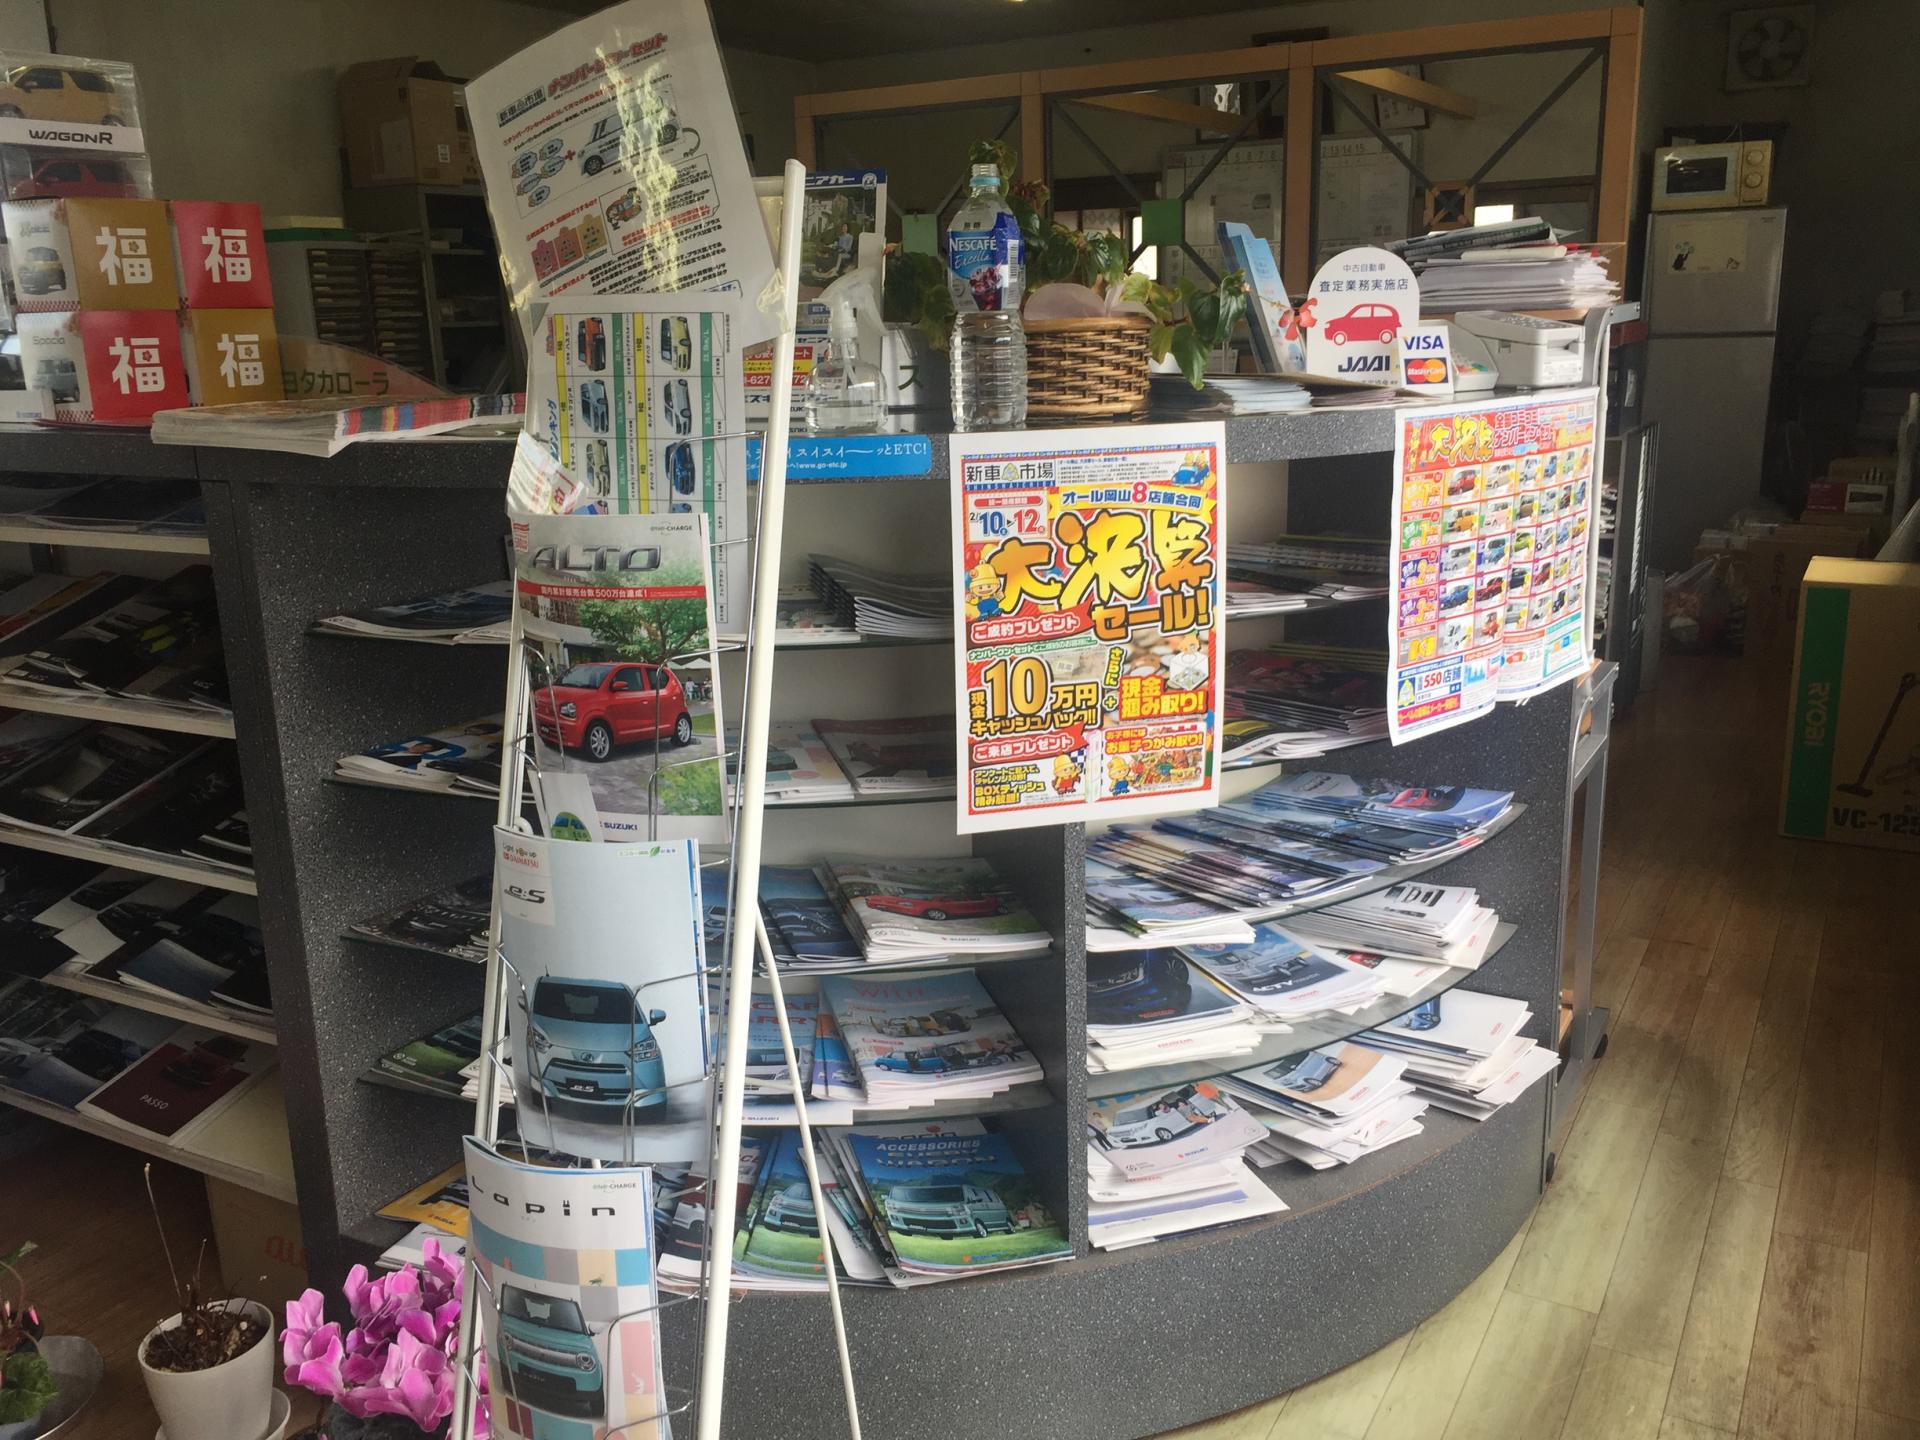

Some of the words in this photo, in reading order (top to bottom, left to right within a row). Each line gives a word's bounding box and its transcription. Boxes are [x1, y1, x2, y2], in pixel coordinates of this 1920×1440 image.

[951, 235, 998, 251] NESCAFÉ
[96, 226, 153, 286] 福
[200, 227, 252, 284] 福
[1342, 263, 1386, 274] 中古自動車
[1319, 278, 1409, 293] 査定業務実施店
[1404, 335, 1445, 351] VISA
[109, 336, 166, 395] 福
[217, 332, 266, 389] 福
[1338, 355, 1391, 373] JAAI
[967, 463, 1001, 483] 新車
[1019, 461, 1054, 481] 市場
[1062, 483, 1203, 509] オール岡山8店舗合同
[529, 545, 662, 572] ALTO
[973, 615, 1080, 639] ご成約プレゼント
[985, 657, 1049, 718] 10
[1120, 676, 1163, 697] 現金
[1423, 673, 1442, 689] 550
[1051, 682, 1099, 709] 万円
[975, 734, 1075, 760] ご来店プレゼント
[603, 820, 639, 832] SUZUKI
[138, 1093, 169, 1111] PASSO
